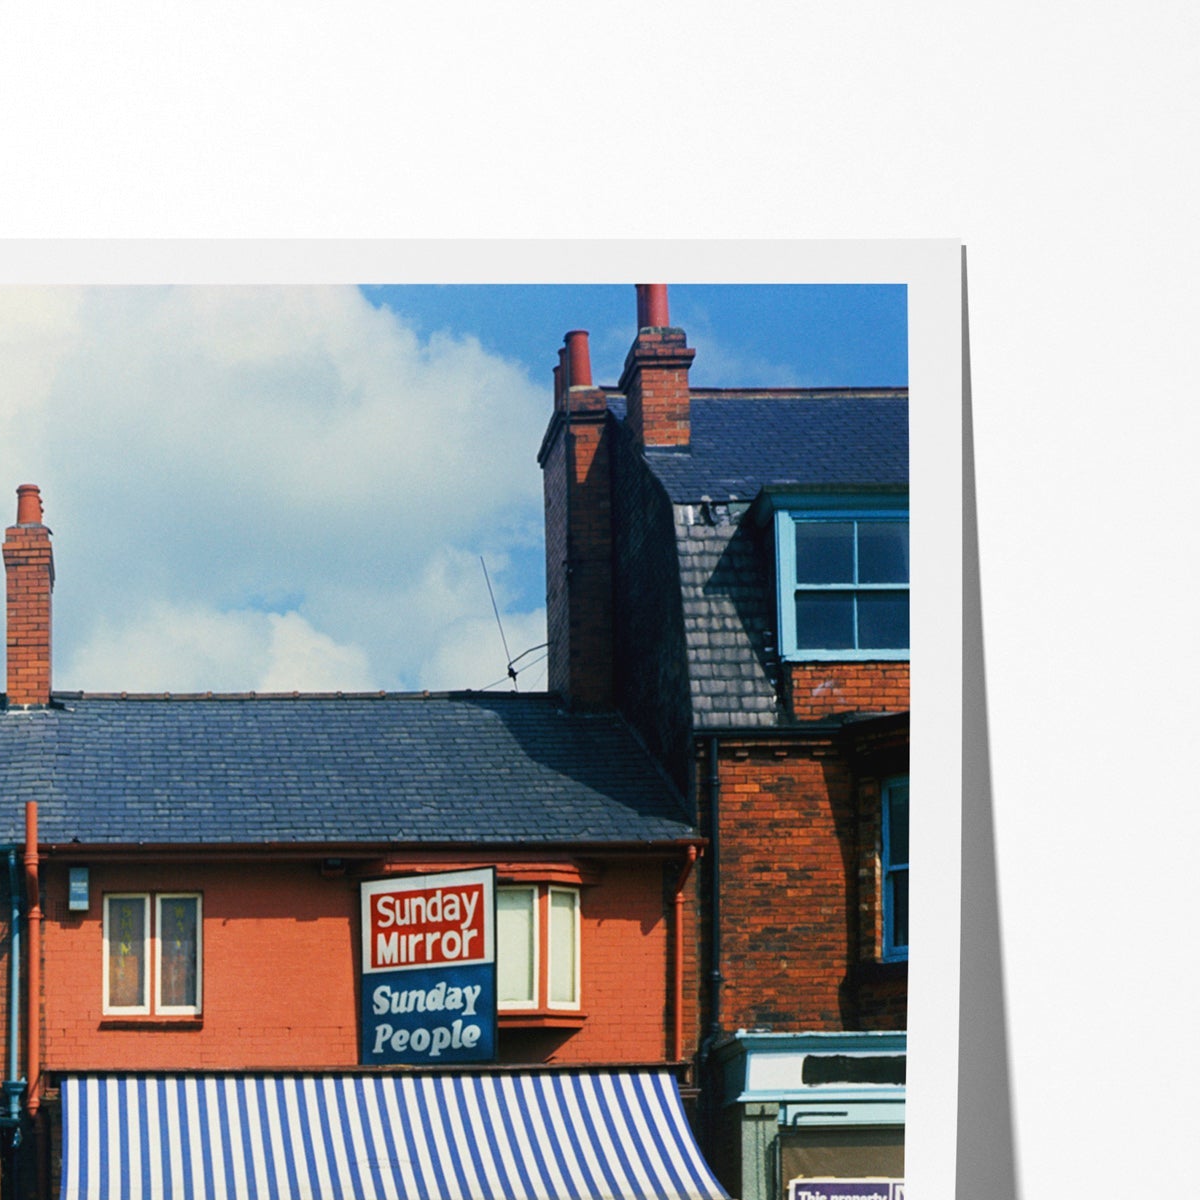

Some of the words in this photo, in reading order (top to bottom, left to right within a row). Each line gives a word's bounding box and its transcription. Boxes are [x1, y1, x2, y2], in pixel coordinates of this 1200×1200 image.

[377, 890, 479, 929] Sunday
[377, 928, 477, 965] Mirror
[372, 981, 481, 1016] Sunday
[372, 1019, 481, 1057] People
